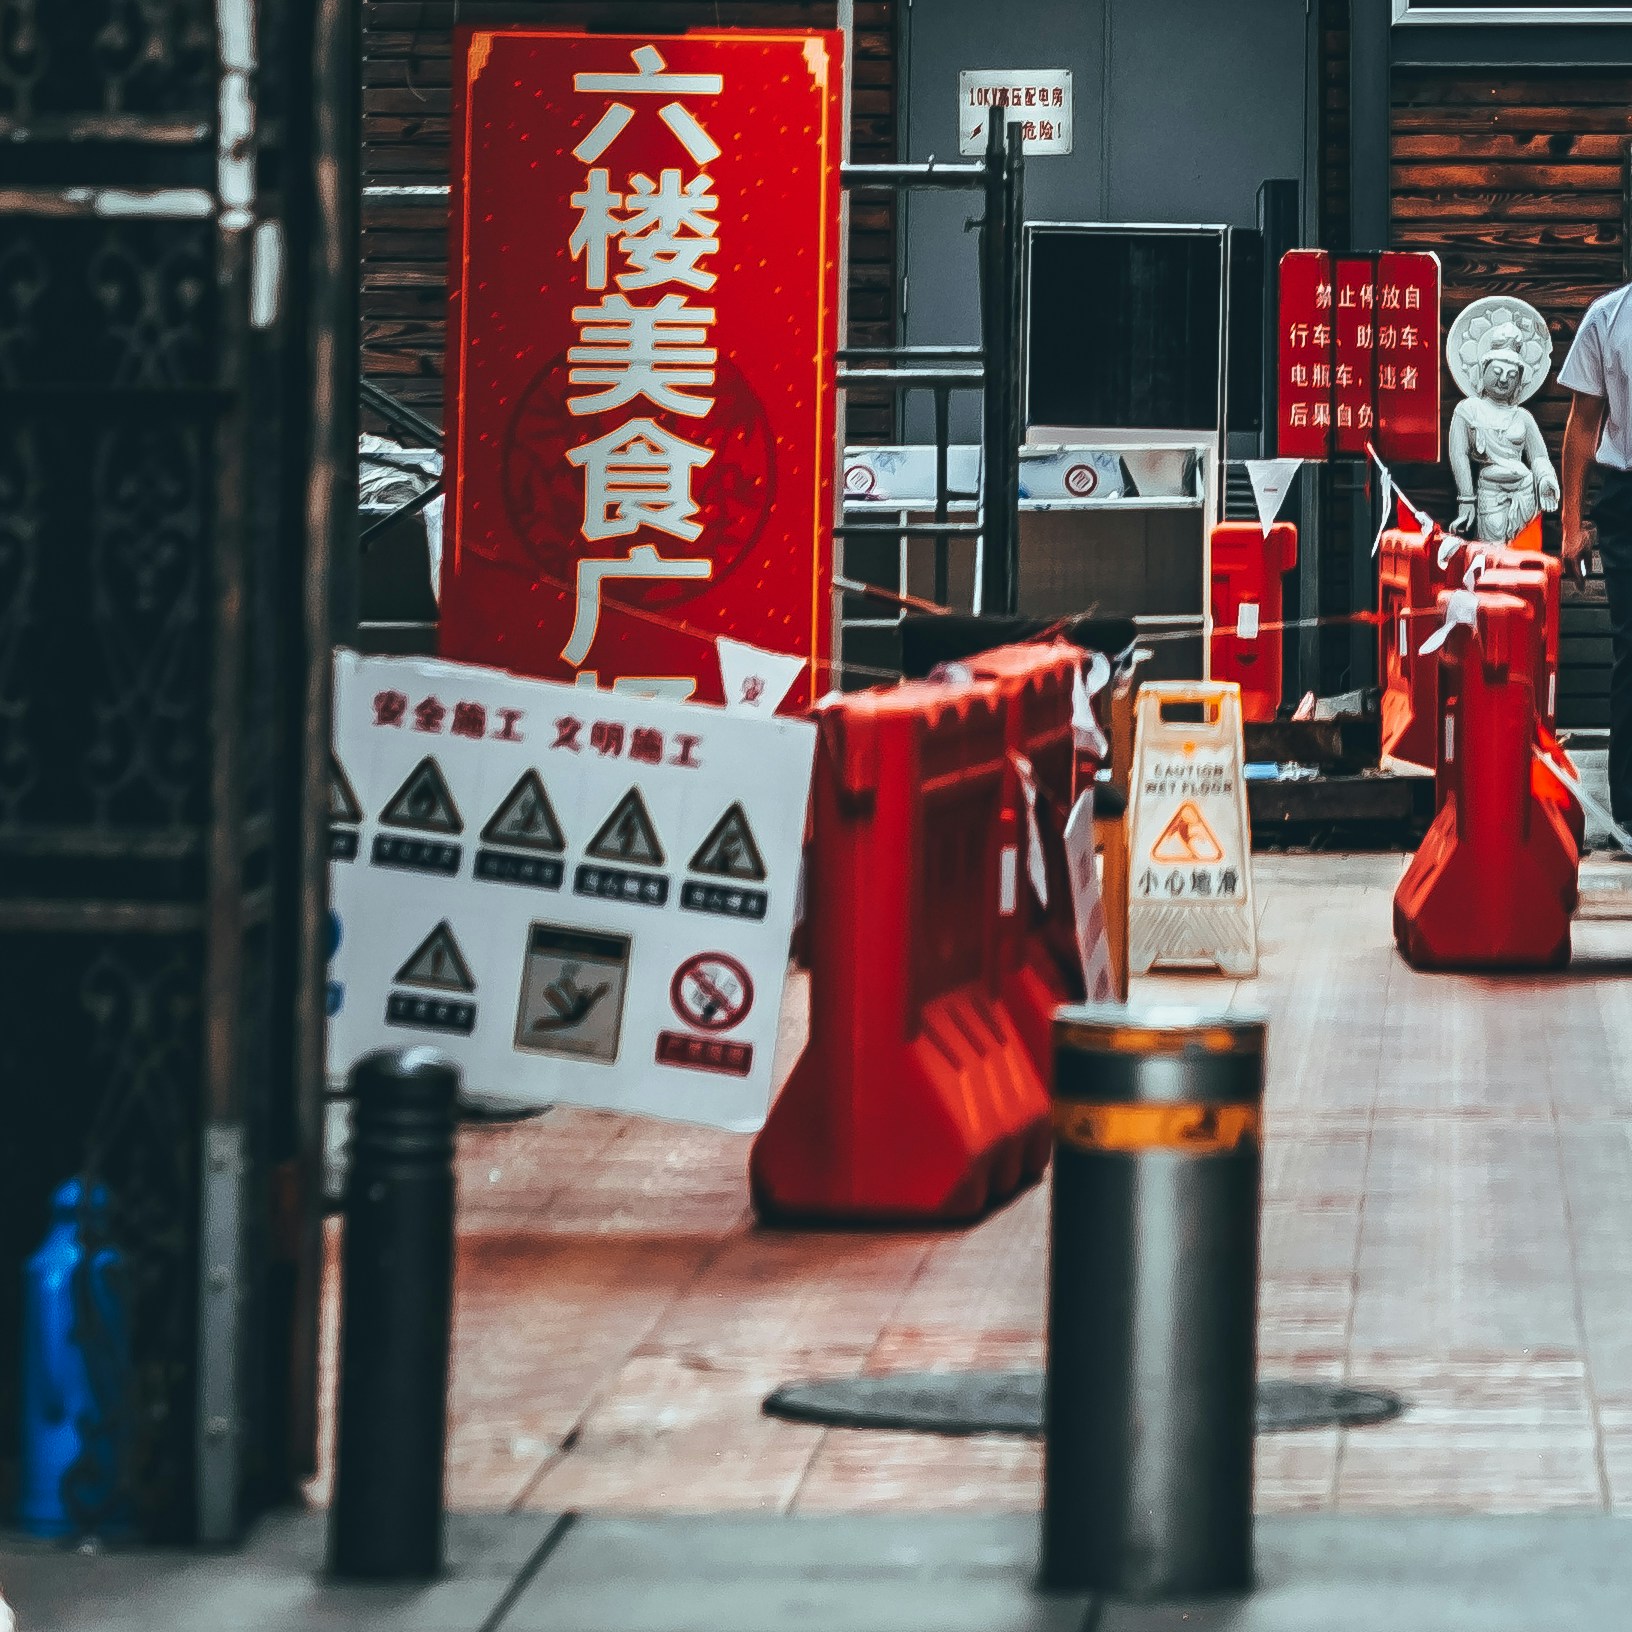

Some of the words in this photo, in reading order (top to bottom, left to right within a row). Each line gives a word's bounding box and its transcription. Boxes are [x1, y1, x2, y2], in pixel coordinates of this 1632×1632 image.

[560, 42, 725, 703] 六楼美食广
